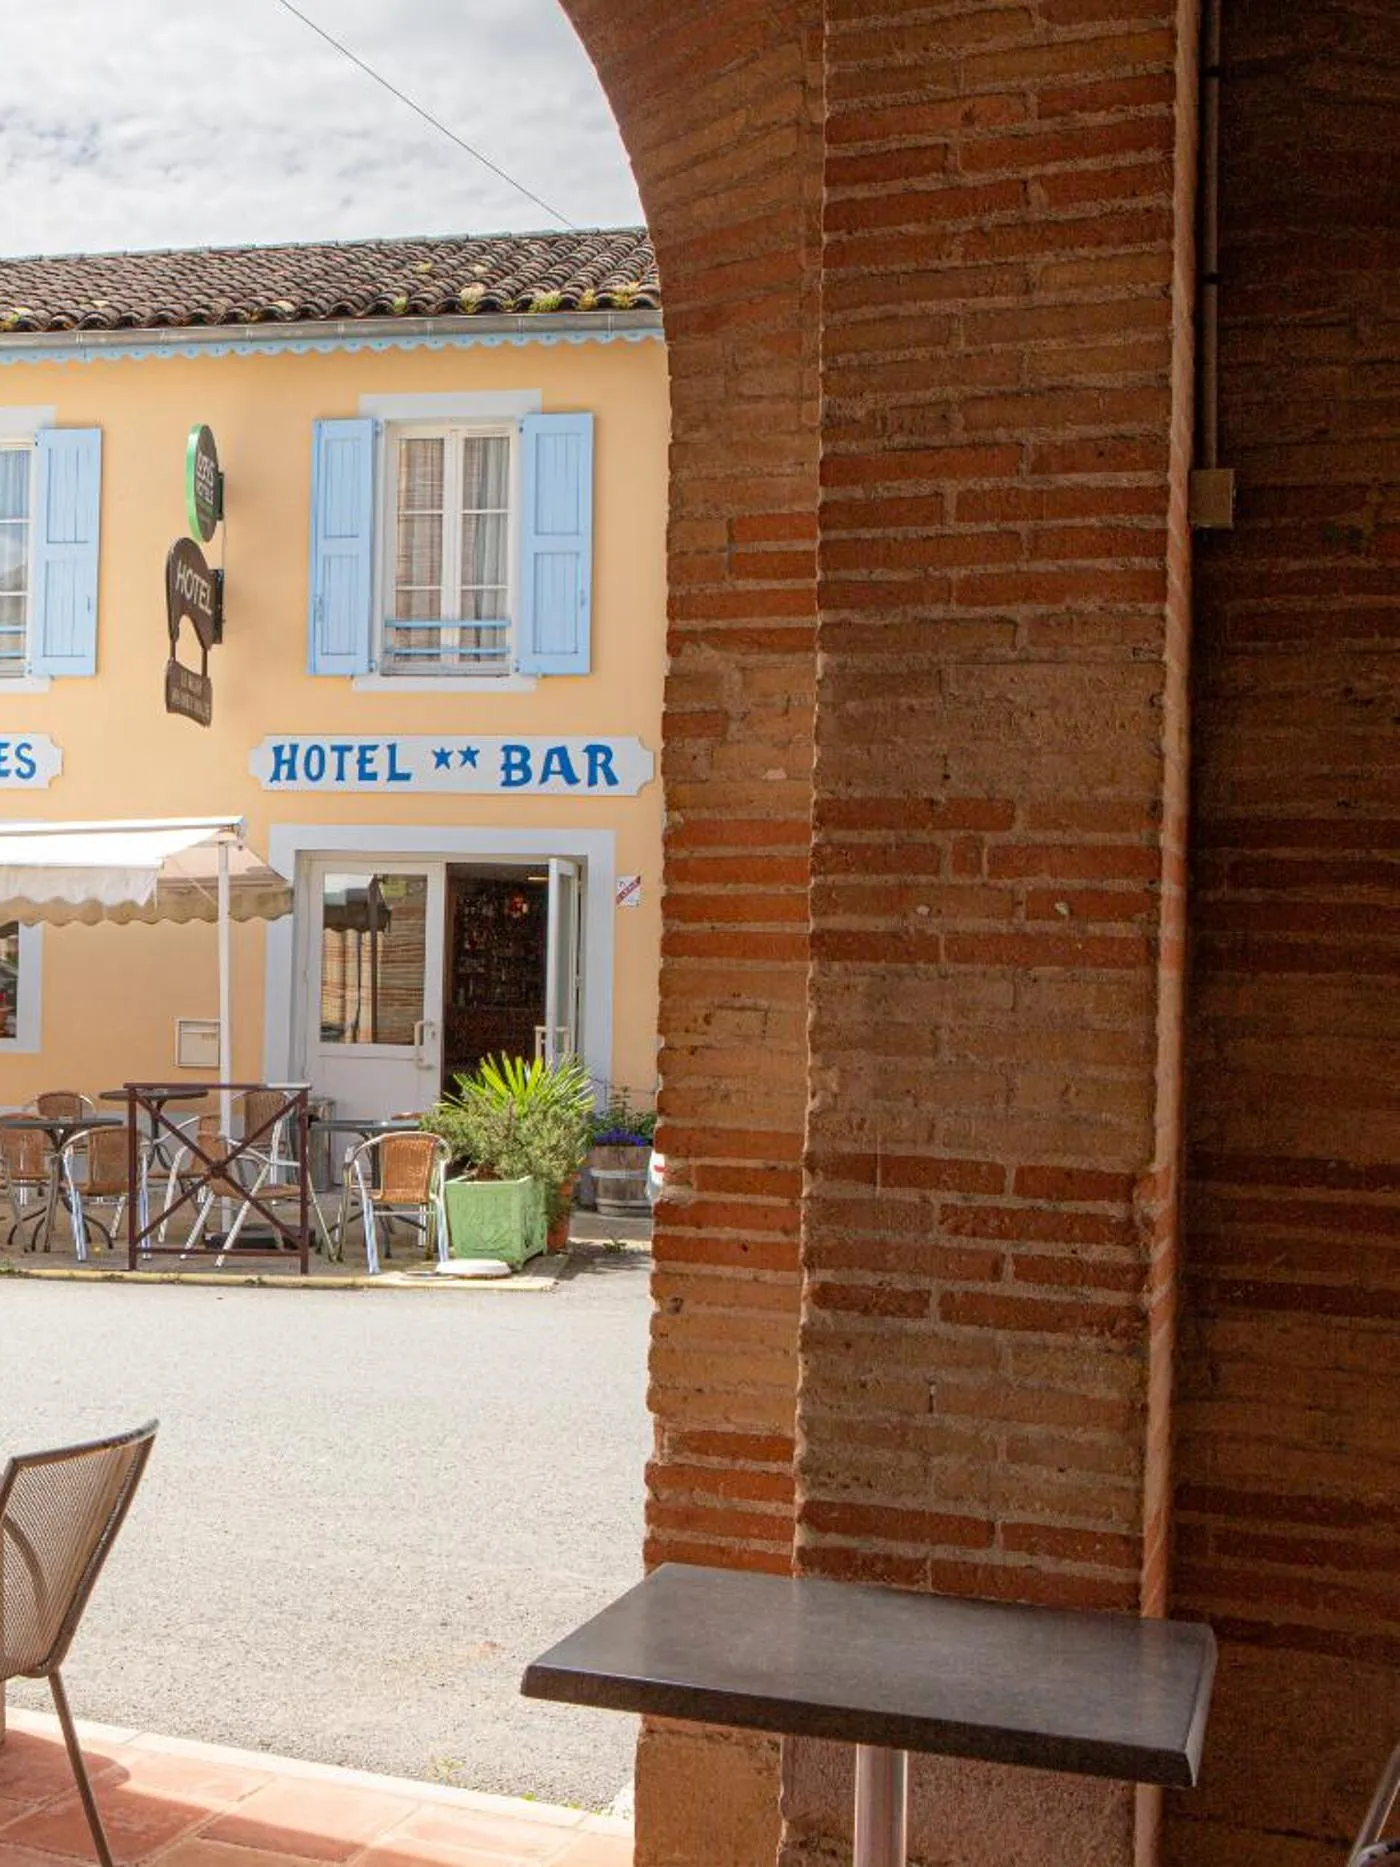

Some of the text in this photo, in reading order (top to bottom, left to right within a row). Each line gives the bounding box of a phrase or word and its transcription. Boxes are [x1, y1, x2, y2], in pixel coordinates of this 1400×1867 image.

[175, 561, 213, 614] HOTEL
[269, 743, 620, 787] HOTEL BAR
